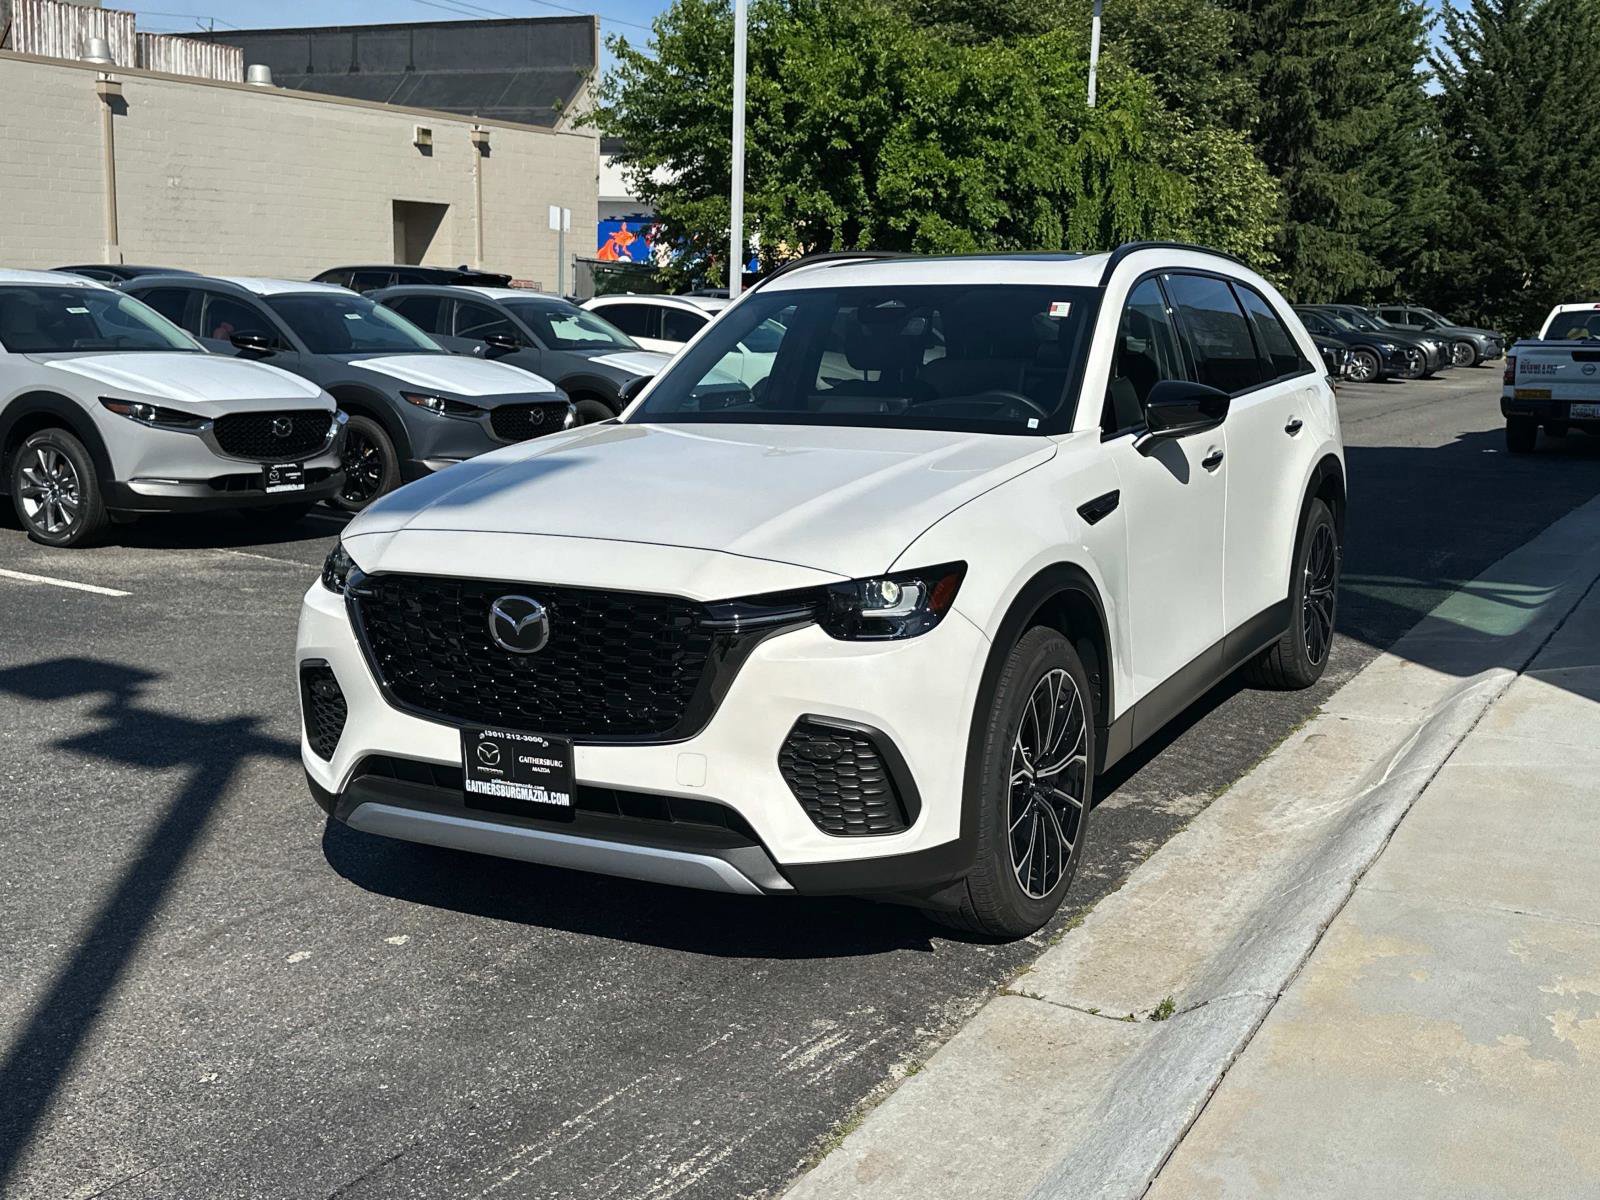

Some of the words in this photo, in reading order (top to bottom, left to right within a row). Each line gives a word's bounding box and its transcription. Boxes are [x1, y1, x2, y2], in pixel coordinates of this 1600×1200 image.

[485, 730, 504, 739] (301)
[506, 733, 543, 743] 212-3000
[518, 755, 563, 768] GAITHERSBURG
[465, 779, 570, 806] GAITHERSBURGMAZDA.COM
